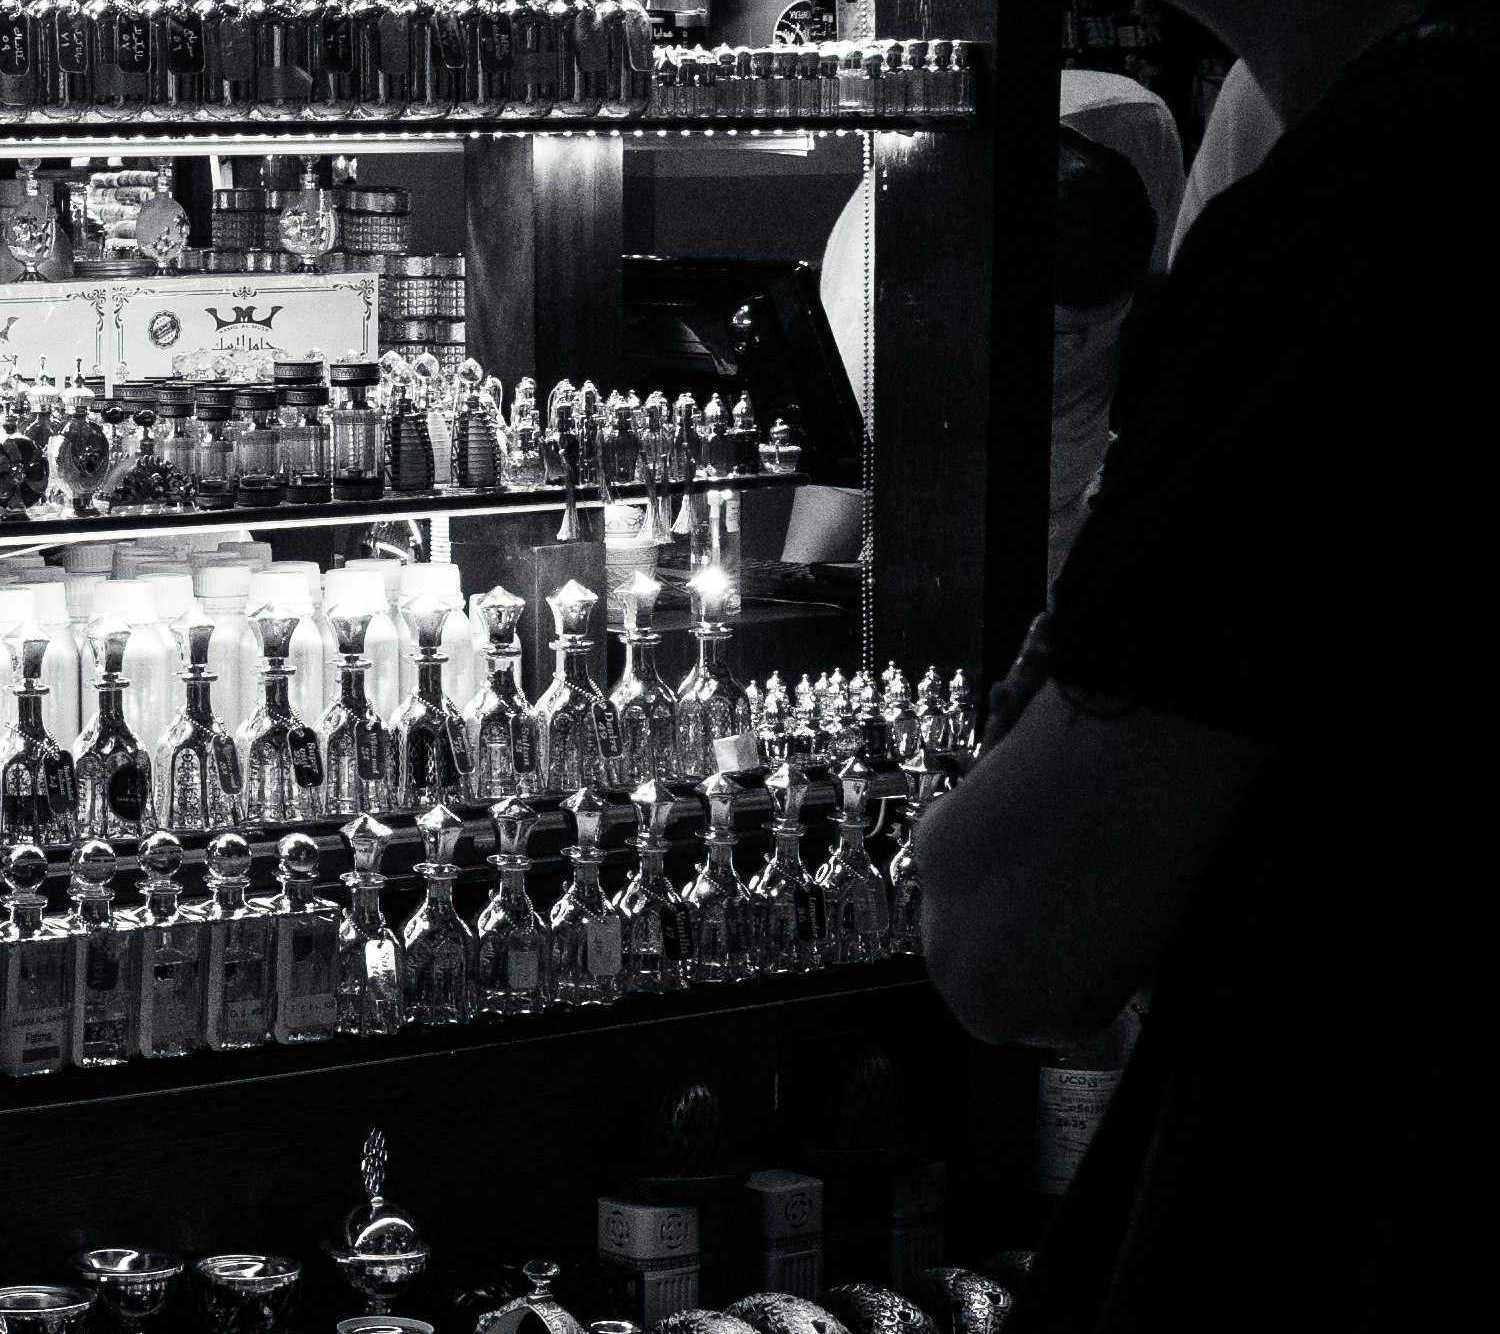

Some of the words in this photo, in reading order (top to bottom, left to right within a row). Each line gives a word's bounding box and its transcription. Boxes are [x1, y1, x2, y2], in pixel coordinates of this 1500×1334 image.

[604, 712, 618, 752] Desire
[307, 742, 319, 774] Super
[676, 910, 690, 954] Vanilla
